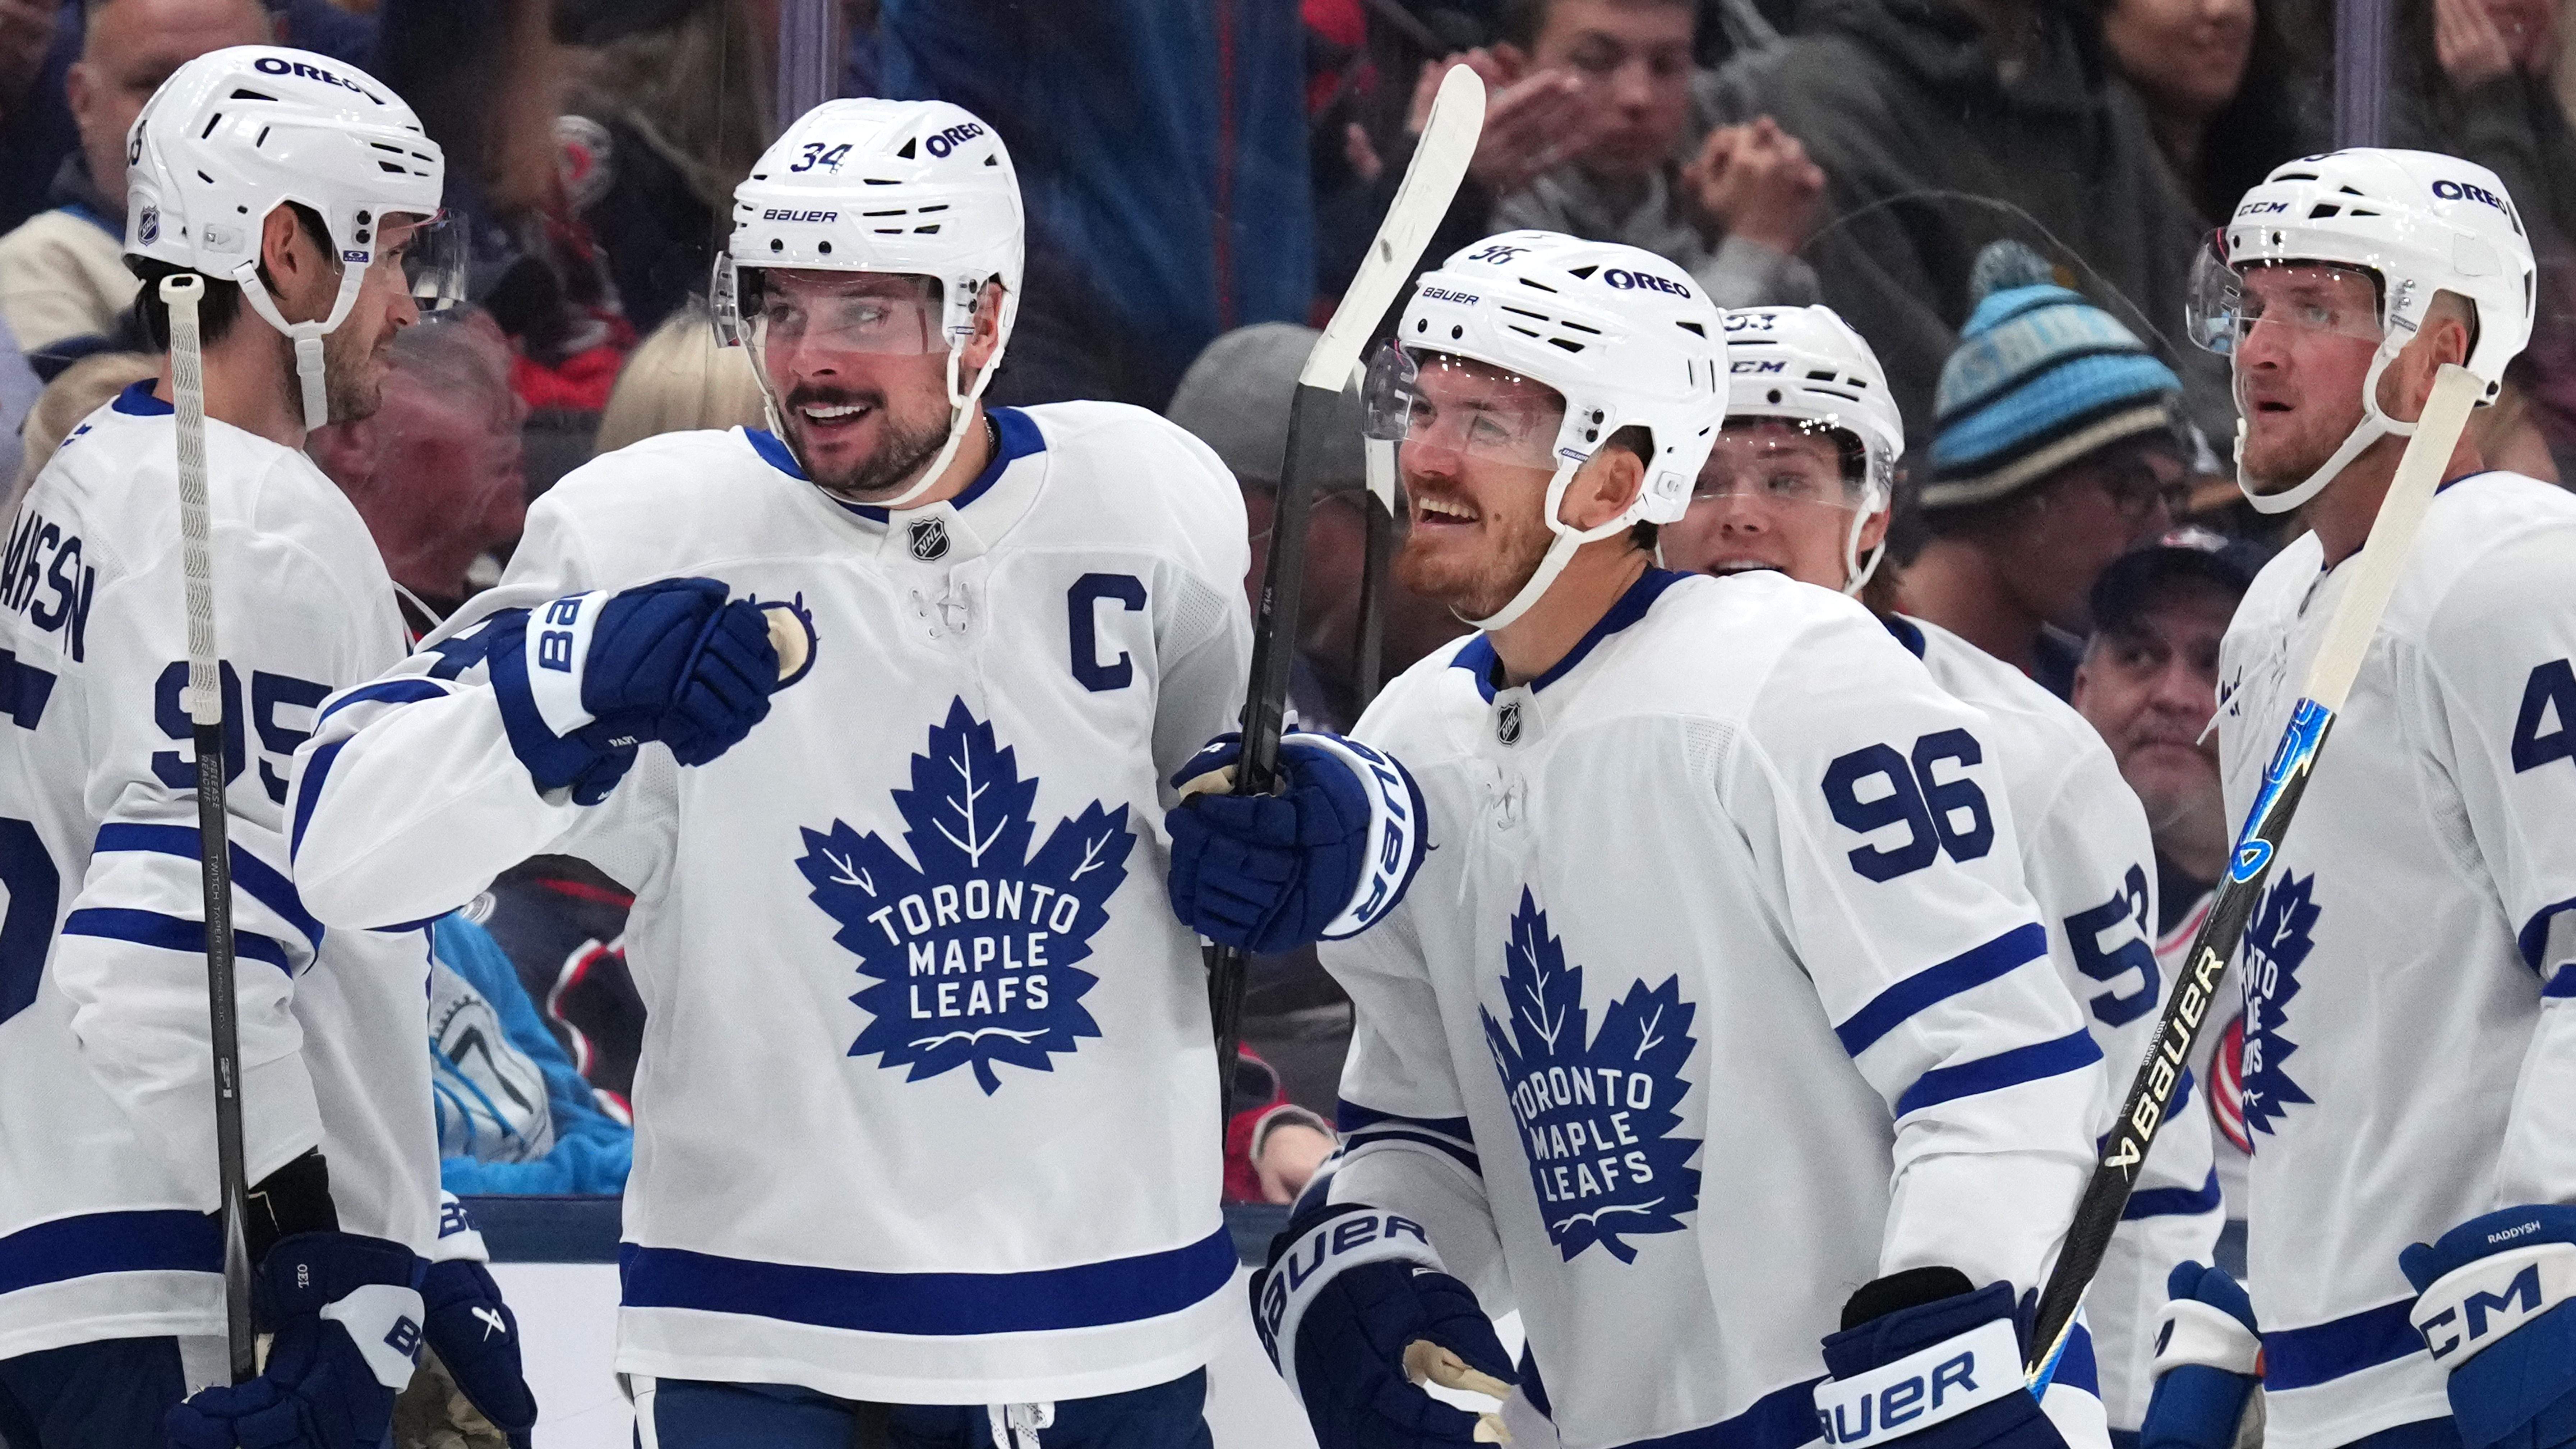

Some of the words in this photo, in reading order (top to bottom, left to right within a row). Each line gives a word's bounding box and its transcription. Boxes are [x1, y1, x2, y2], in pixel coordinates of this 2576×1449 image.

[254, 58, 360, 92] OREO
[791, 142, 854, 174] 34
[926, 122, 984, 158] OREO
[2238, 202, 2288, 217] CCM
[2432, 180, 2507, 215] OREO
[763, 209, 837, 223] BAUER
[1469, 246, 1531, 264] 96
[1422, 287, 1479, 305] BAUER
[1604, 268, 1690, 299] OREO
[1730, 360, 1786, 373] CM
[919, 527, 941, 555] NHL
[1068, 573, 1147, 692] C
[1502, 712, 1517, 739] NHL
[210, 759, 220, 809] RELEASE
[1821, 728, 1994, 883] 96
[1326, 735, 1405, 923] AUER
[211, 854, 220, 900] TWITCH
[867, 879, 1079, 945] TORONTO
[909, 932, 1048, 976] MAPLE
[910, 975, 1048, 1018] LEAFS
[2132, 946, 2224, 1141] BAUER
[1512, 1066, 1652, 1129] TORONTO
[1530, 1112, 1638, 1160] MAPLE
[1540, 1151, 1653, 1201] LEAFS
[2488, 1220, 2540, 1243] RADDYSH
[297, 1264, 309, 1288] OEL
[2419, 1261, 2542, 1361] CM
